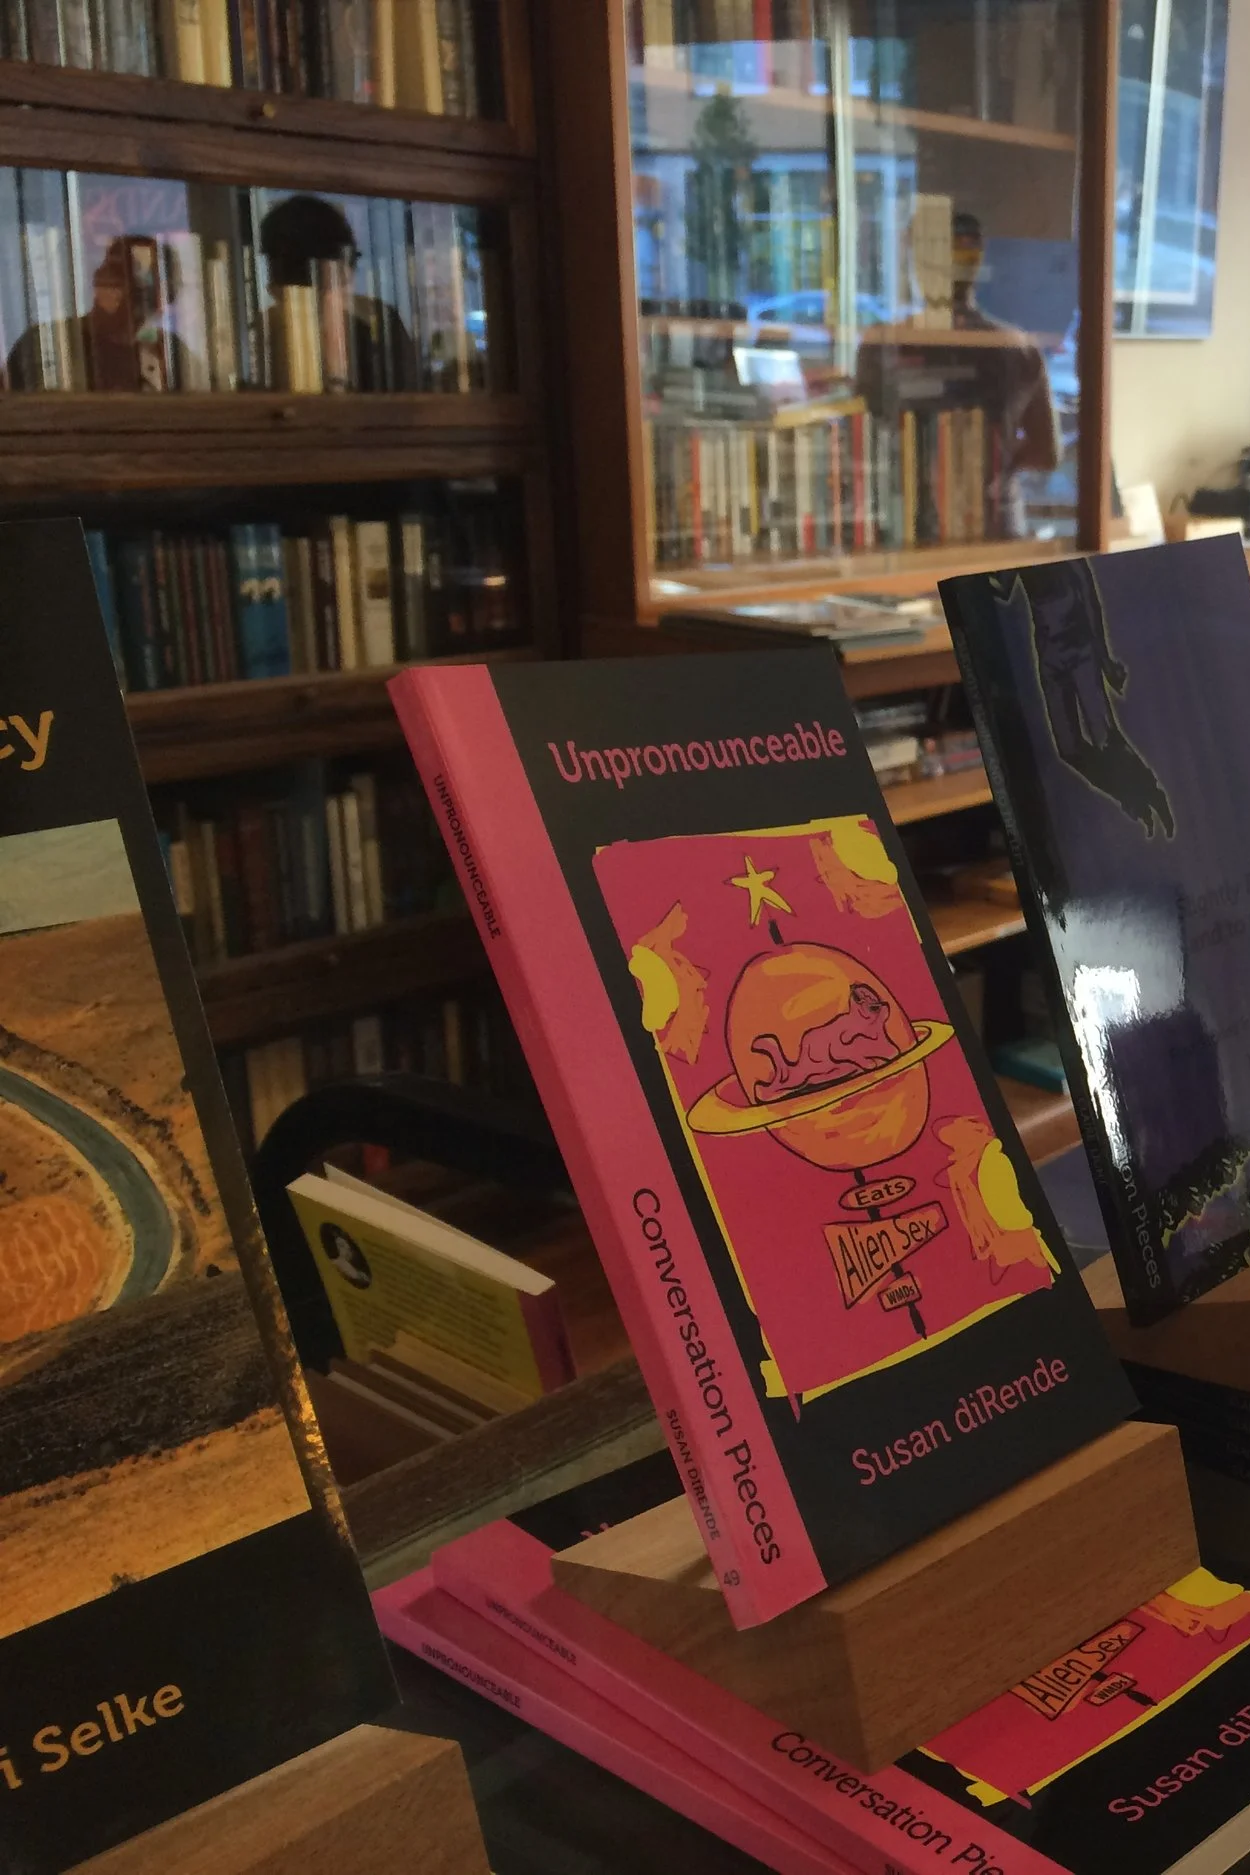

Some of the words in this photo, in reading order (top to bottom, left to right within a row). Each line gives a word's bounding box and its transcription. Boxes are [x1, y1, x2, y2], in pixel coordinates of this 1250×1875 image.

[547, 721, 848, 789] Unpronounceable
[433, 773, 502, 940] UNPRONOUNCEABLE
[854, 1179, 906, 1206] Eats
[837, 1226, 897, 1297] Alien
[892, 1215, 937, 1250] Sex
[1131, 1201, 1163, 1289] Pieces
[885, 1283, 916, 1306] WMDs
[632, 1187, 734, 1438] Conversation
[724, 1439, 781, 1565] Pieces
[851, 1418, 952, 1486] Susan
[954, 1357, 1070, 1434] diRende
[665, 1408, 692, 1464] SUSAN
[687, 1466, 721, 1542] DIRENDE
[723, 1569, 741, 1588] 49
[485, 1593, 578, 1666] UNPRONOUNCEABLE
[421, 1641, 521, 1709] UNPRONOUNCEABLE
[1020, 1657, 1092, 1713] Alien
[1079, 1632, 1129, 1665] Sex
[1094, 1676, 1130, 1701] WMDs
[32, 1684, 185, 1772] Selke
[771, 1731, 953, 1856] Conversation
[1108, 1746, 1224, 1823] Susan
